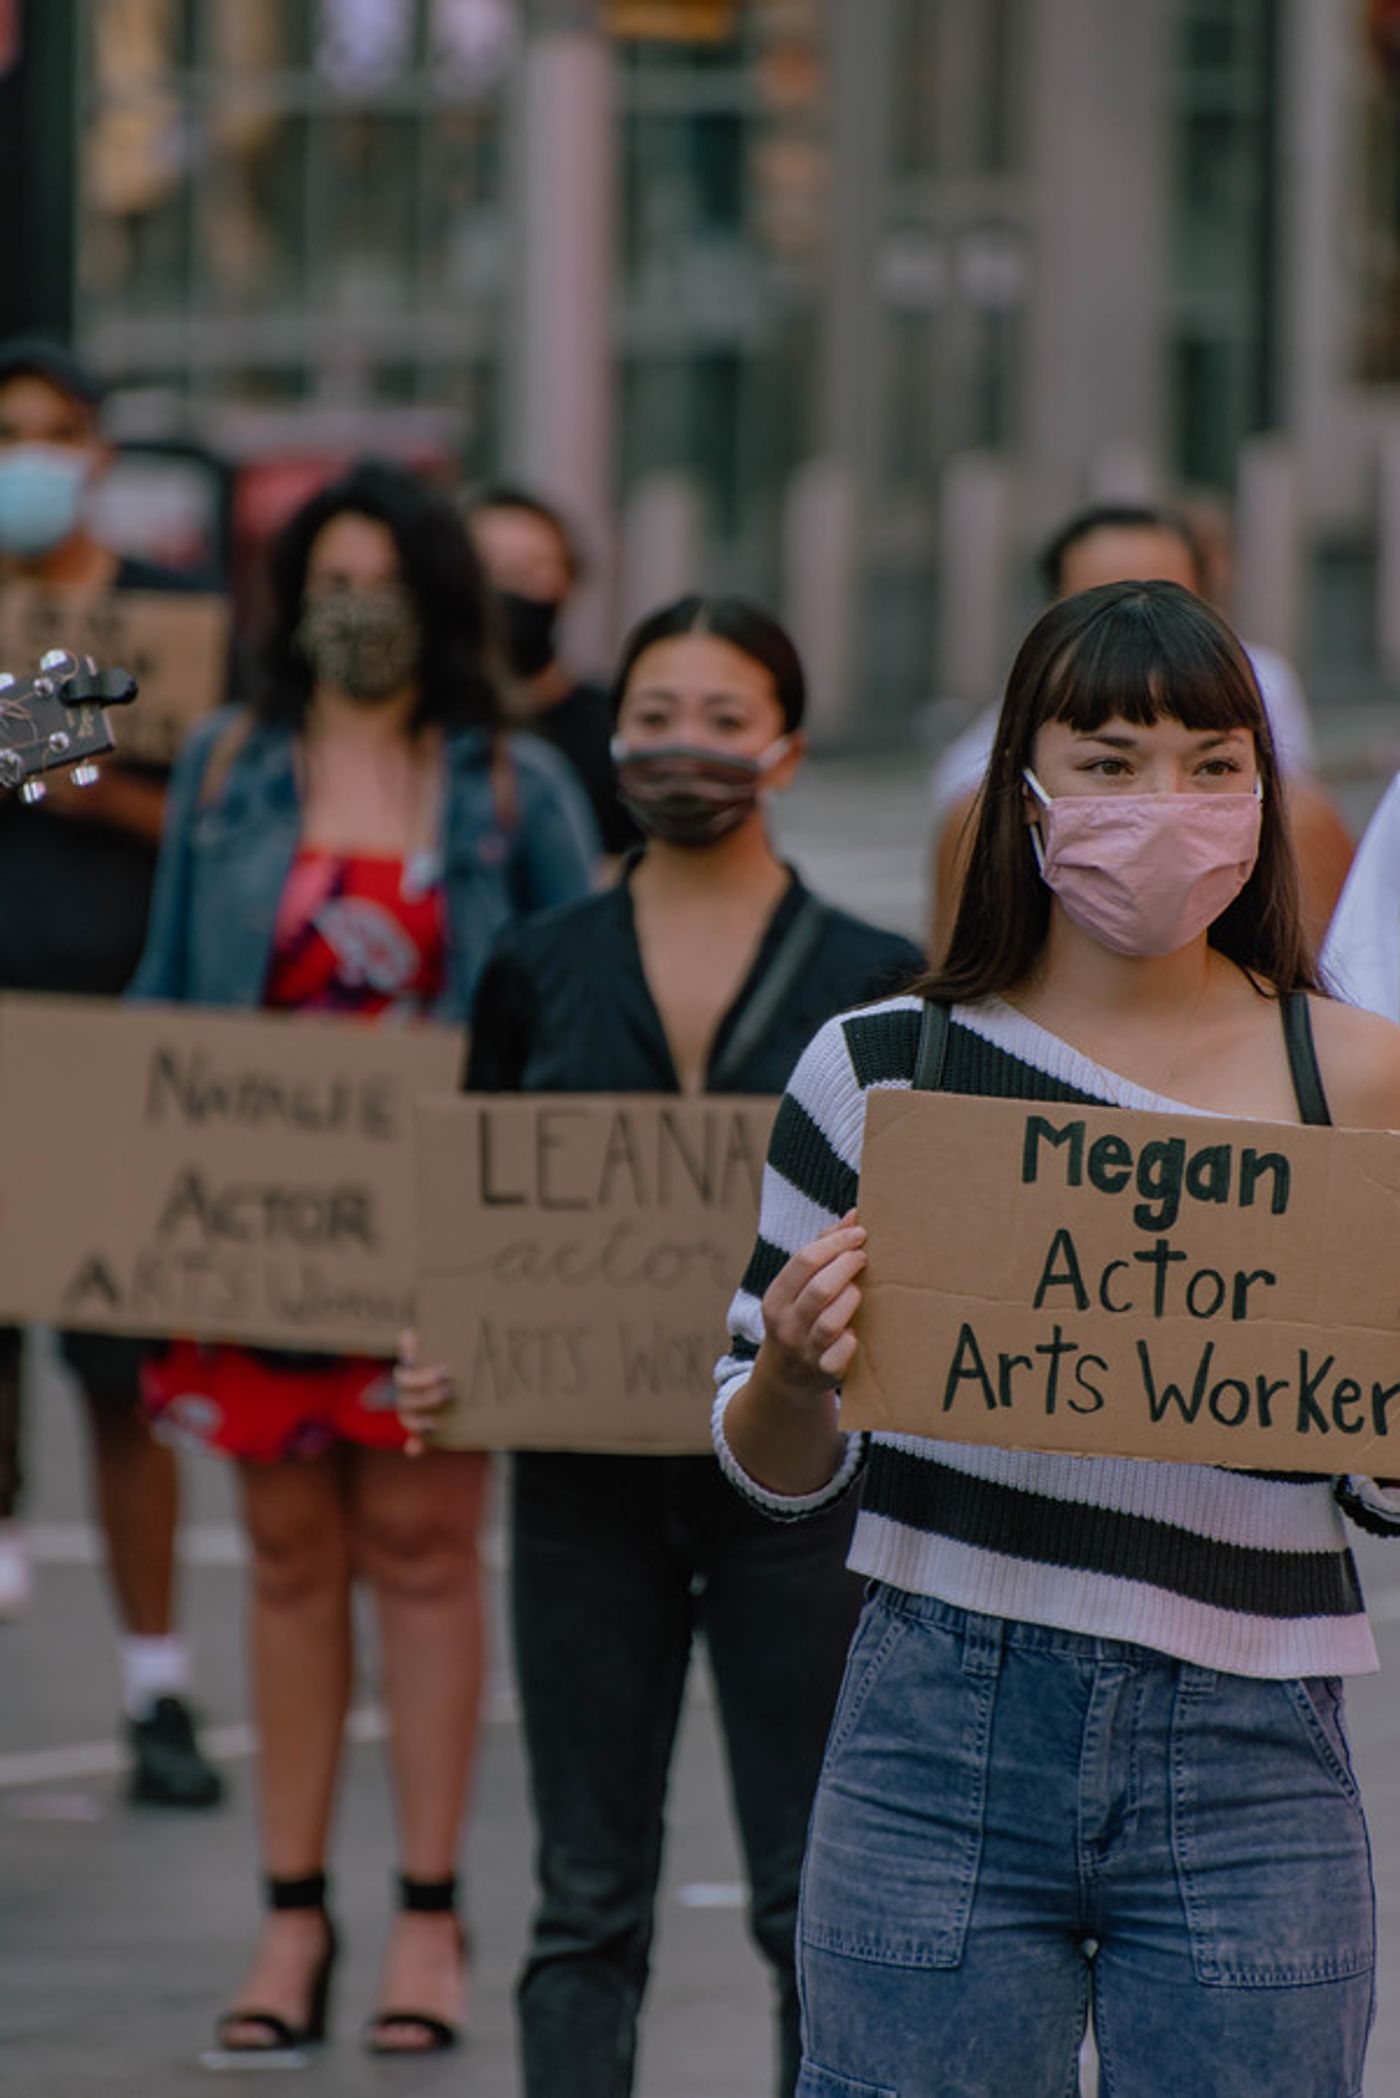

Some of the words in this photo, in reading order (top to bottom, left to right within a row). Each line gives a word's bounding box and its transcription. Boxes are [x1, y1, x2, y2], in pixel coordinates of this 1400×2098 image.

[1022, 1115, 1291, 1231] Megan
[1033, 1228, 1277, 1320] Actor
[942, 1322, 1108, 1414] Arts
